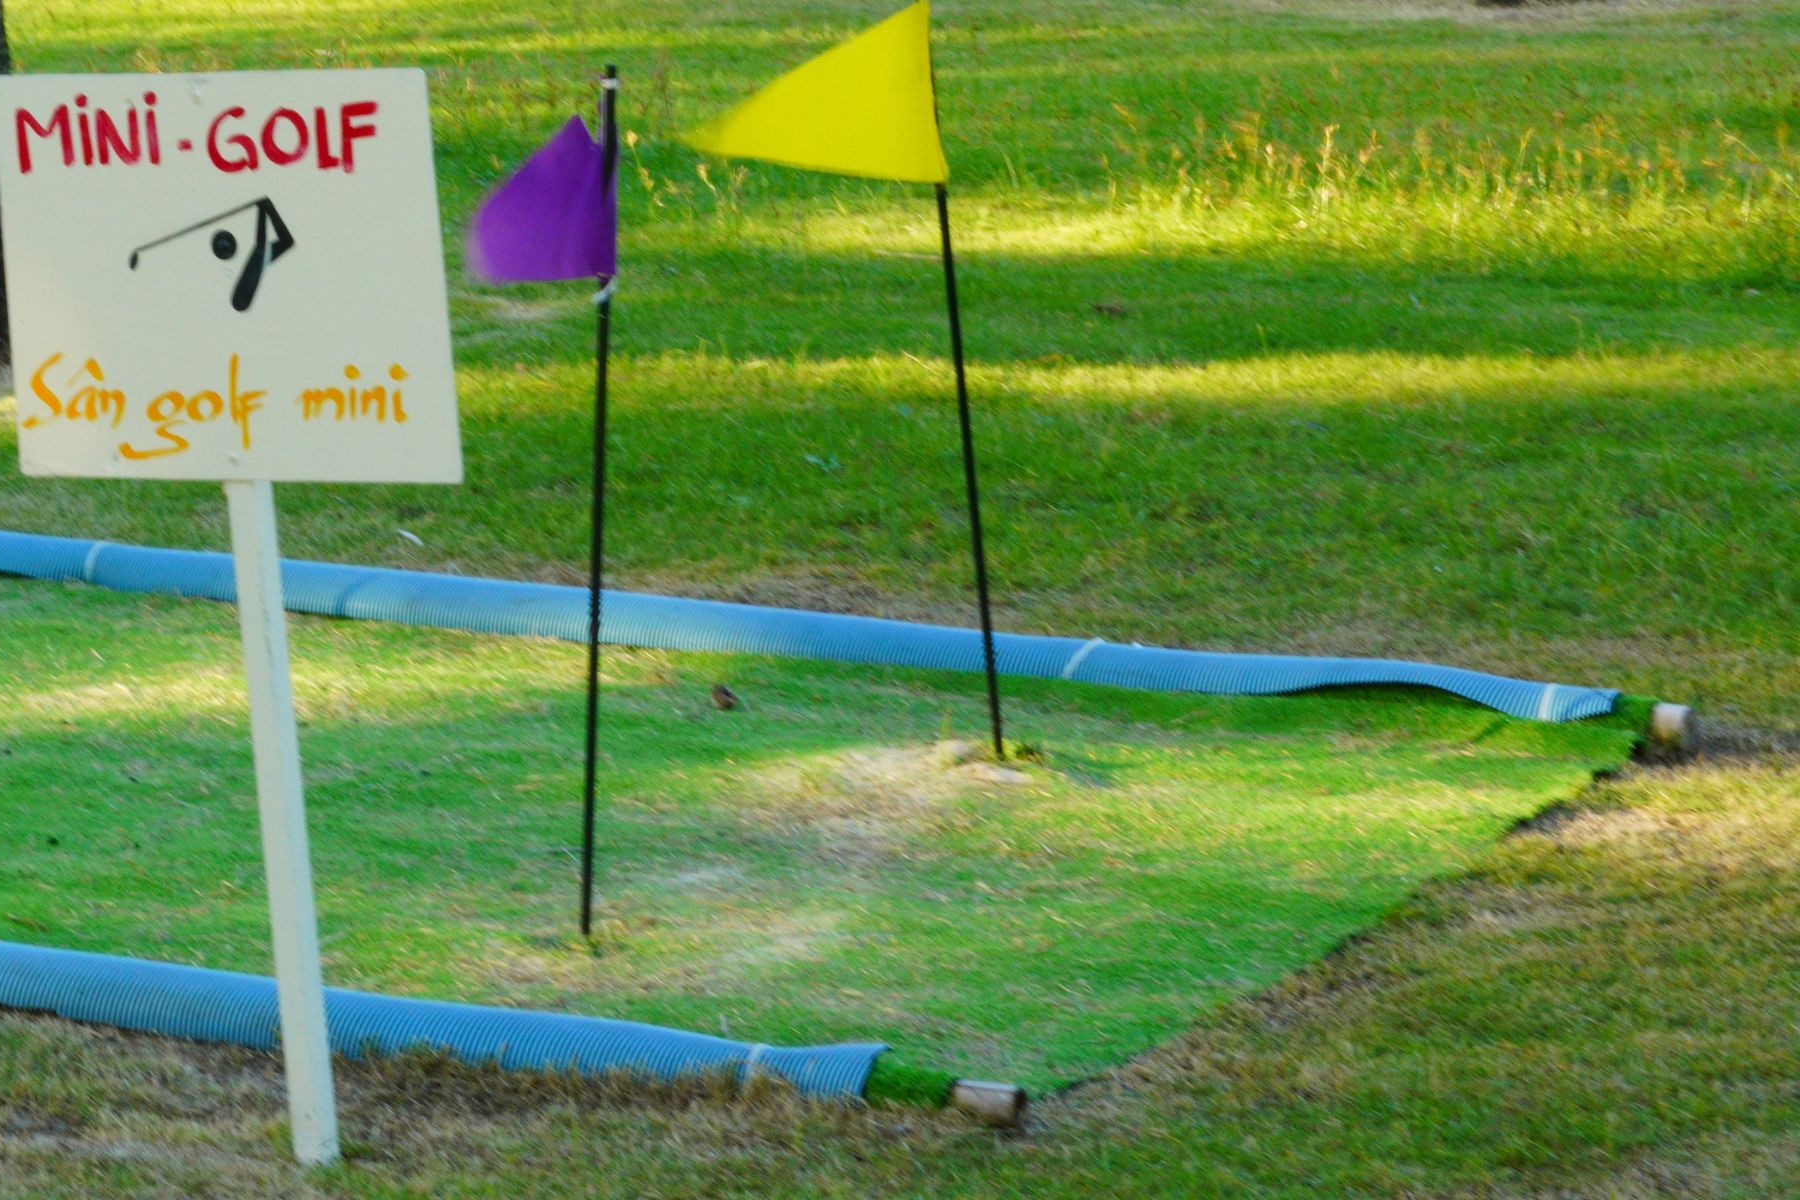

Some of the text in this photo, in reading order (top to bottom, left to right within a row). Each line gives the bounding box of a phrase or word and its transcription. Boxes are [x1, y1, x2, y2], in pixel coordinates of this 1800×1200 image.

[22, 351, 410, 461] Sân golf mini
